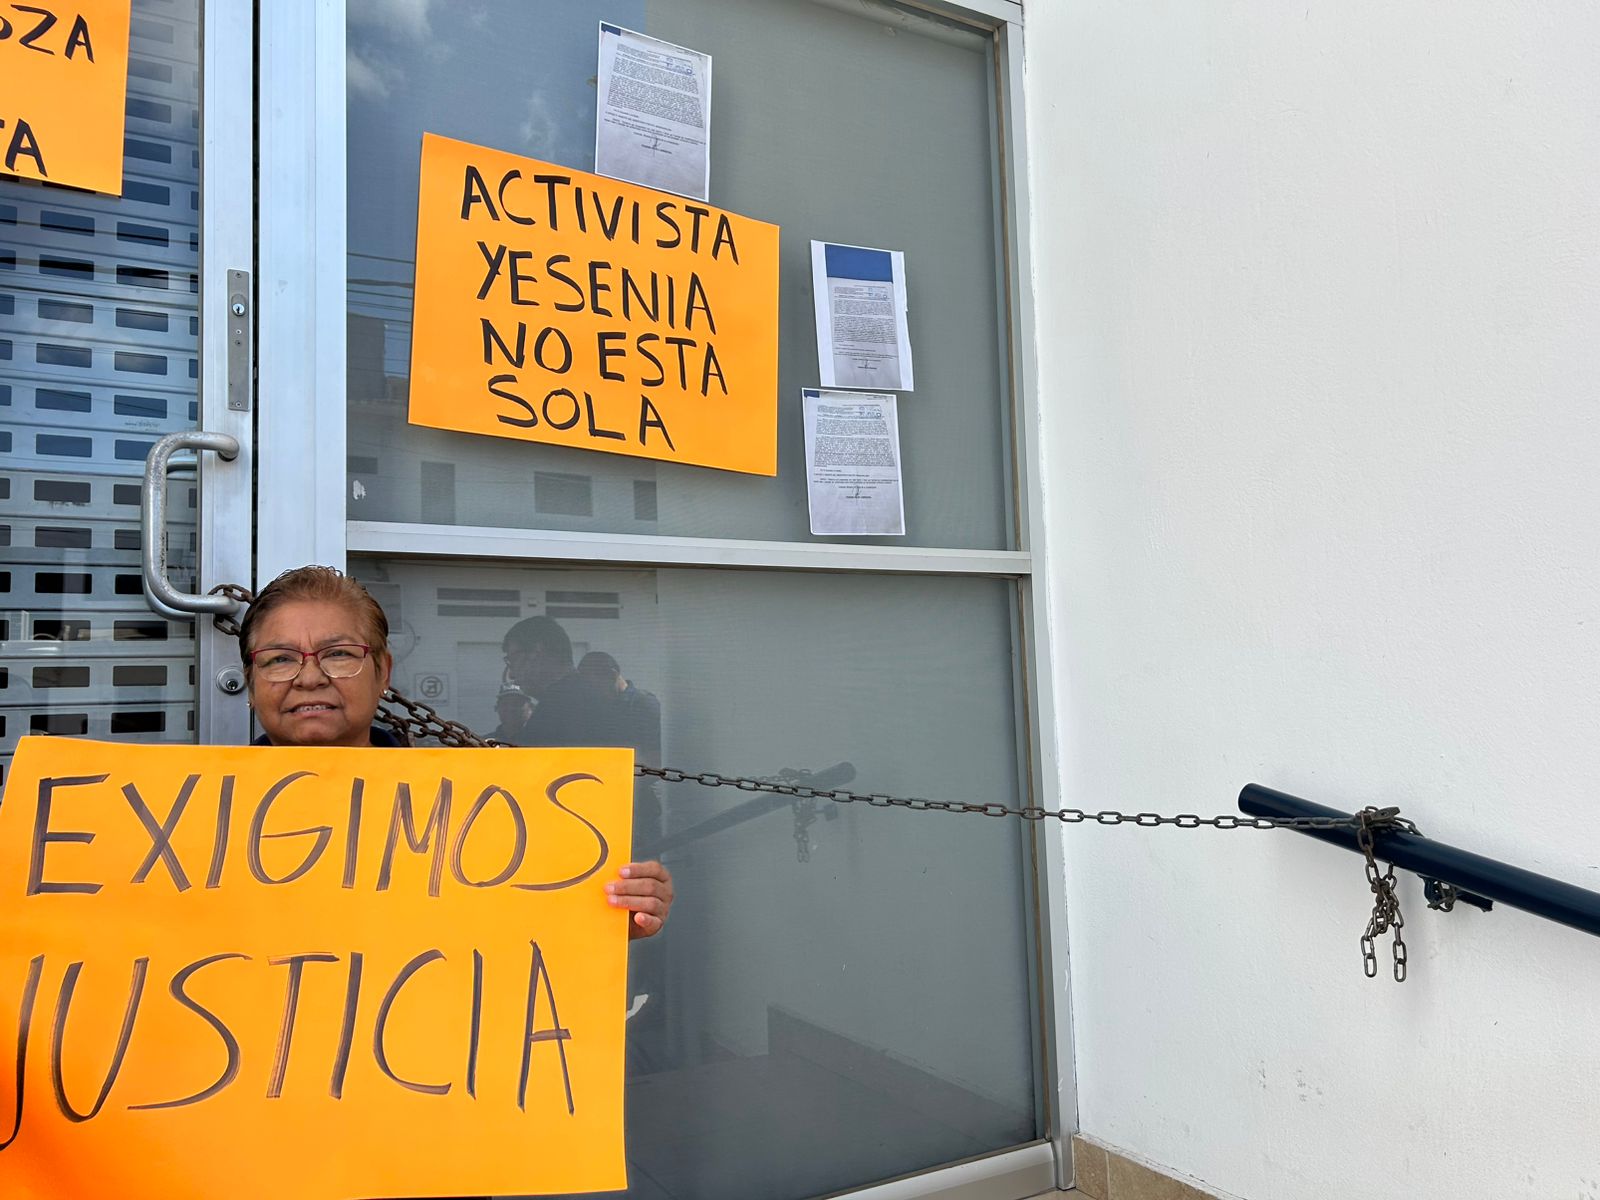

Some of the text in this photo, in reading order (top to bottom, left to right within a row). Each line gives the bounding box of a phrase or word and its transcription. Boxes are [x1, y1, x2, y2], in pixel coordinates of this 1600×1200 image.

[0, 118, 48, 177] A
[460, 165, 739, 265] ACTIVISTA
[476, 241, 716, 335] YESENIA
[480, 317, 728, 397] NO ESTA
[487, 374, 676, 452] SOLA
[26, 770, 610, 898] EXIGIMOS
[0, 938, 576, 1151] JUSTICIA
